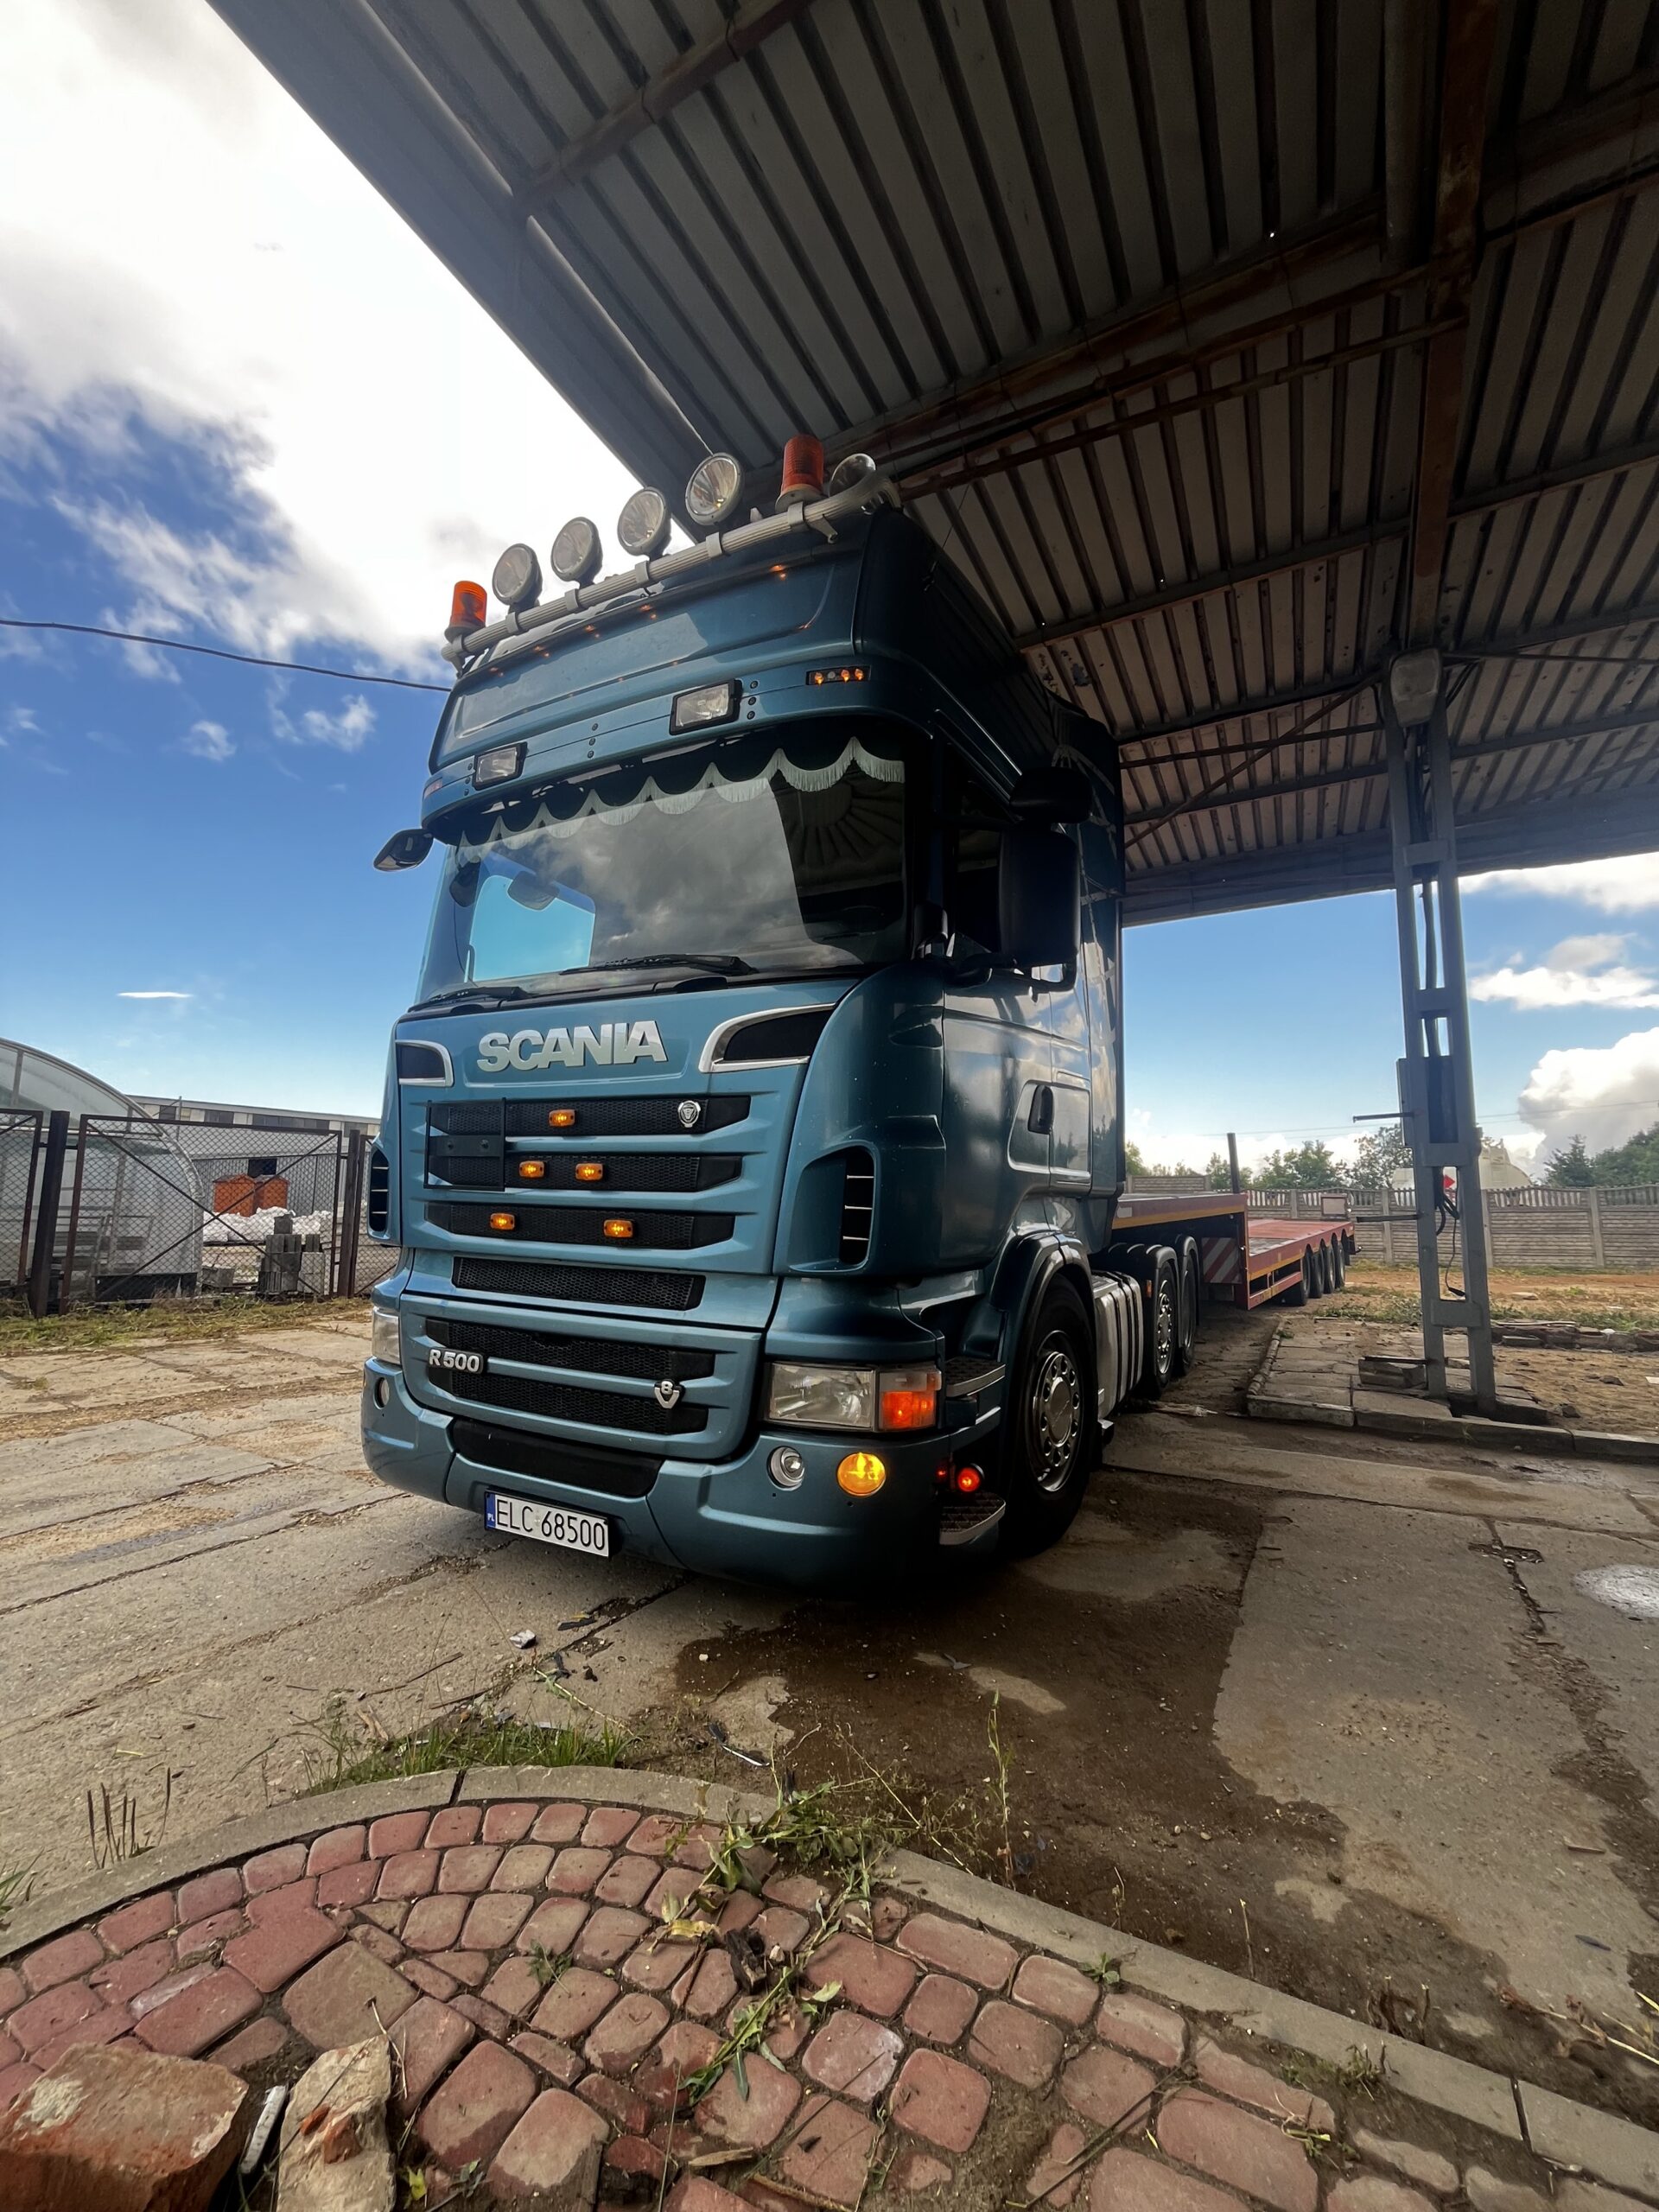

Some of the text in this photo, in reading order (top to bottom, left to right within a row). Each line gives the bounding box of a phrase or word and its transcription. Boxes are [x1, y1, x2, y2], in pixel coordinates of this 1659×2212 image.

[477, 1020, 669, 1072] SCANIA
[429, 1349, 480, 1372] R 500
[487, 1513, 495, 1522] PL
[497, 1499, 606, 1551] ELC 68500
